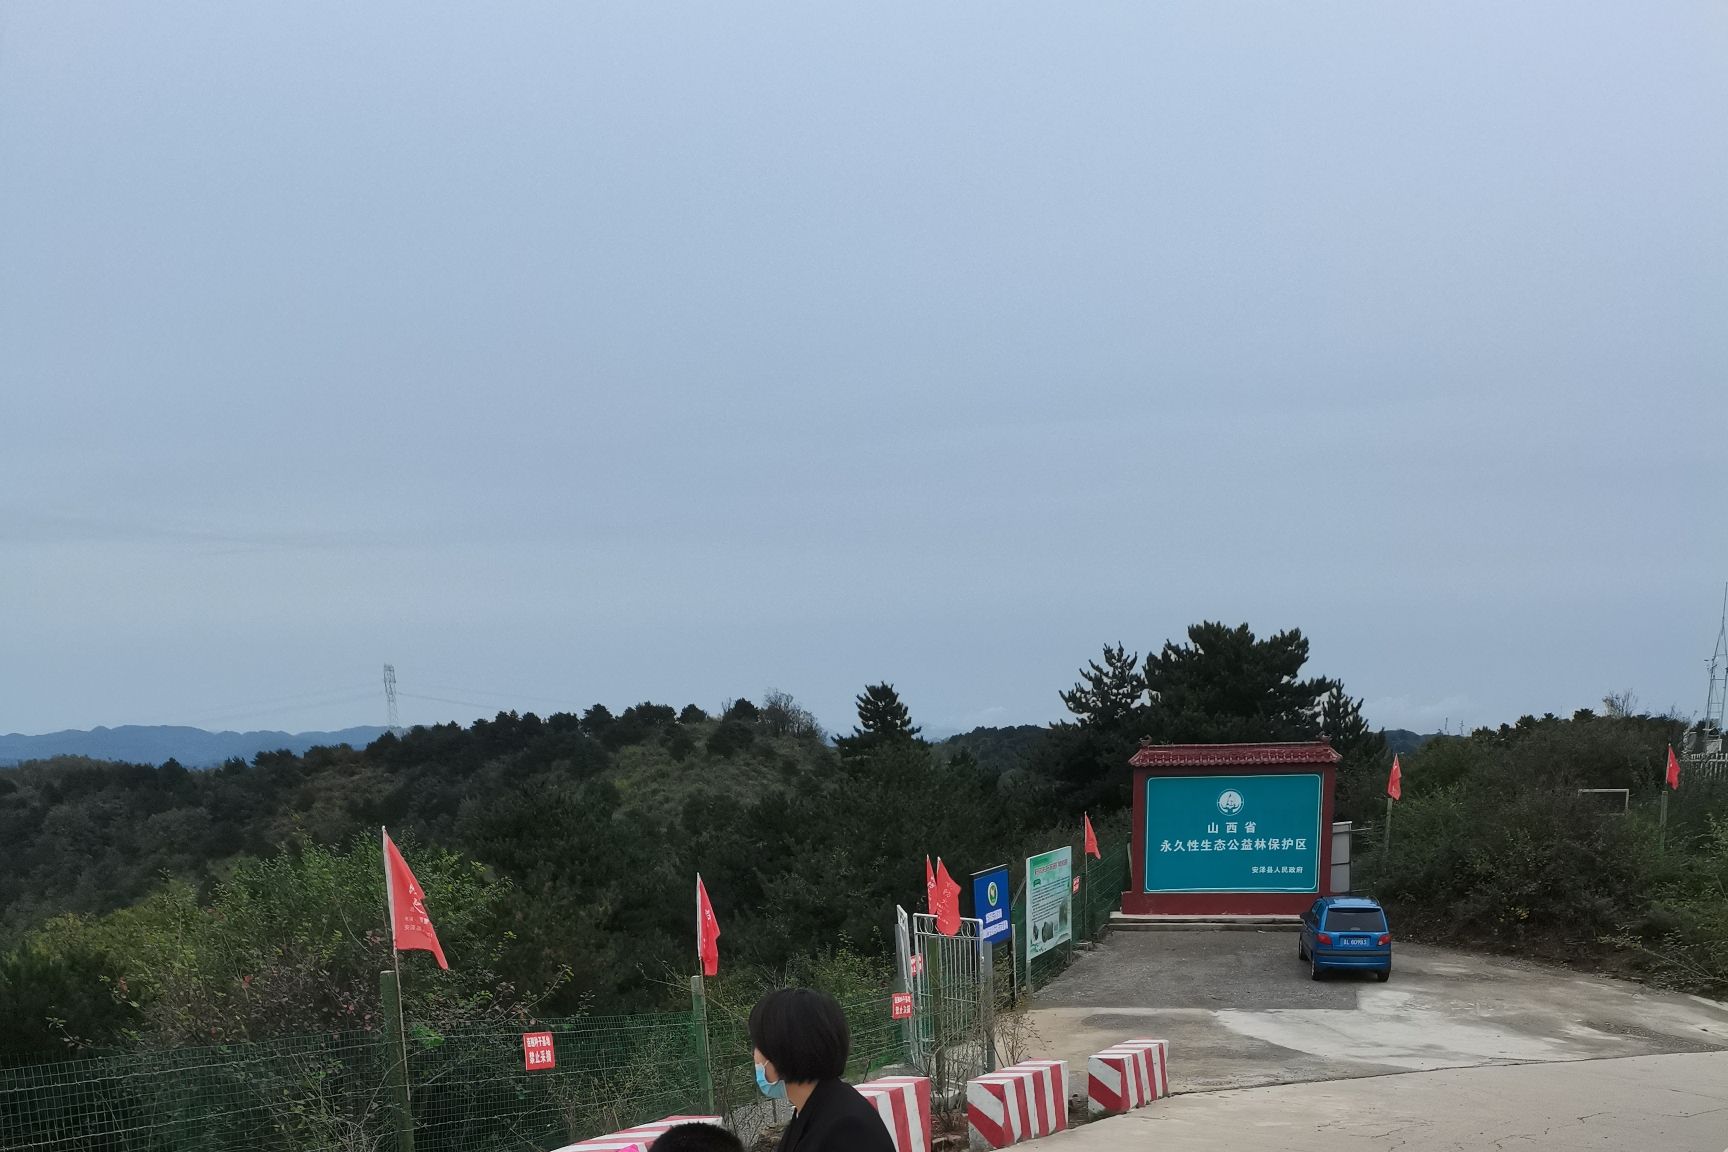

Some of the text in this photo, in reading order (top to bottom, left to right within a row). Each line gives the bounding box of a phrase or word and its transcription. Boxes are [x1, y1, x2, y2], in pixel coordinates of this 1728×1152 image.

[1207, 821, 1257, 834] 山西省
[1160, 838, 1307, 852] 永久性生态公益林保护区
[1251, 866, 1304, 874] 安泽县人民政府
